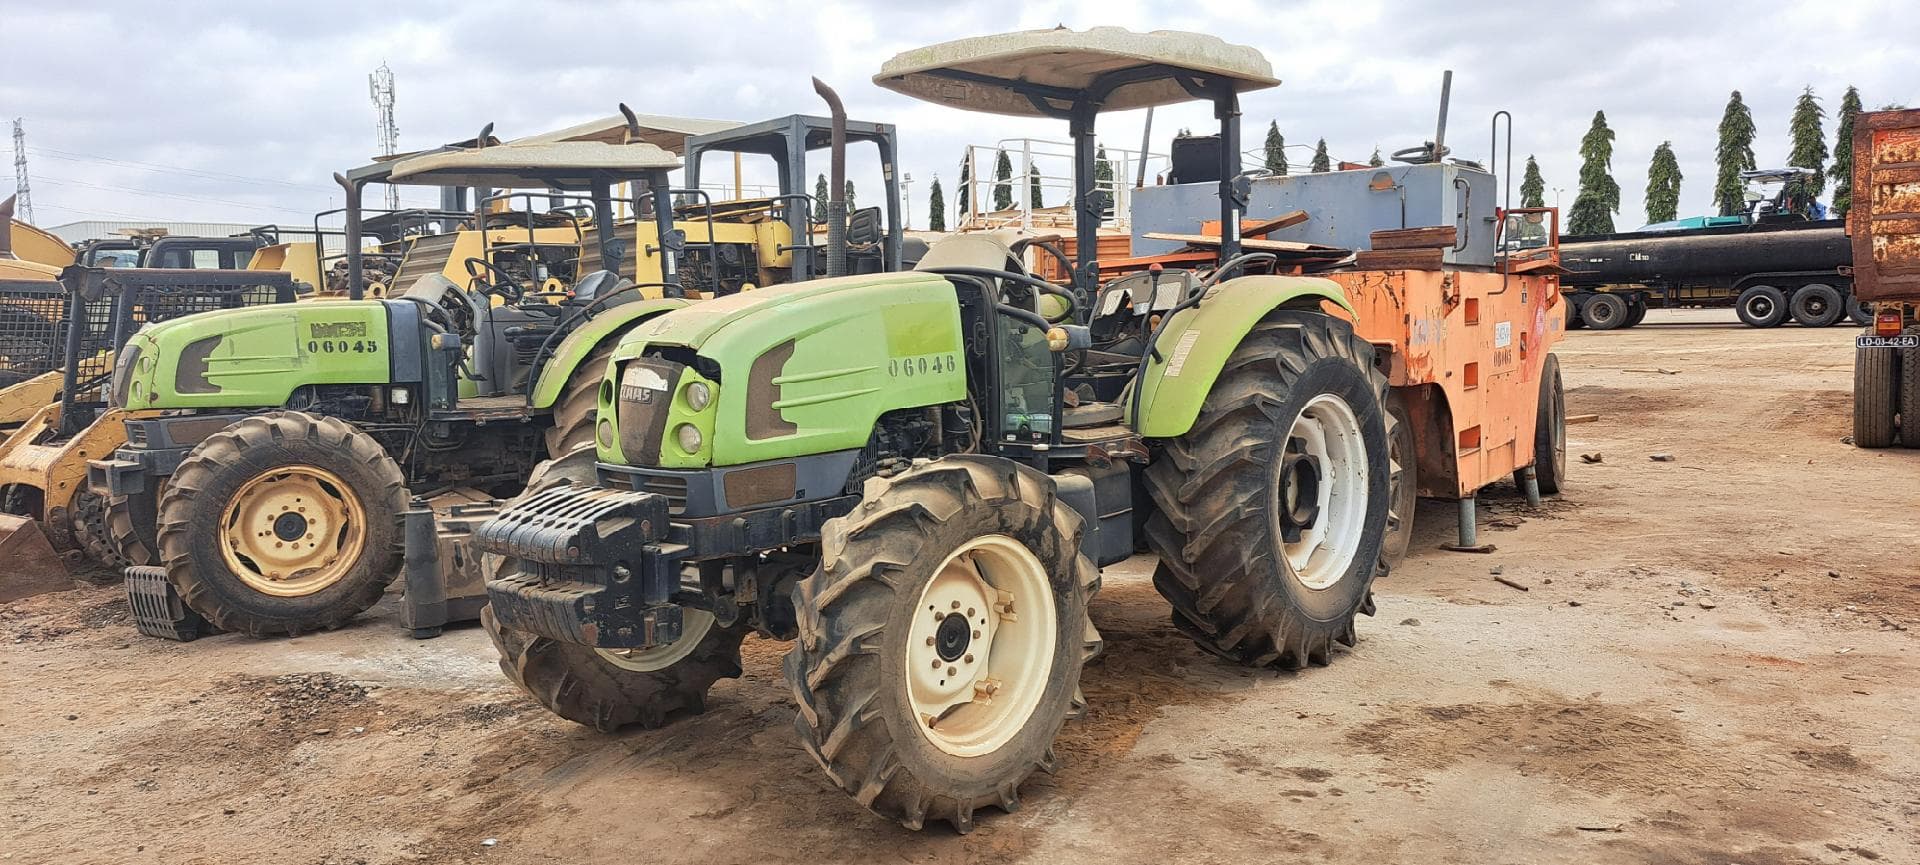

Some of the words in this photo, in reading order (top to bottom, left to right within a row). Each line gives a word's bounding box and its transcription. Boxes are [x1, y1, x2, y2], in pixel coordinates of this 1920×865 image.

[308, 340, 378, 353] 06045
[1860, 337, 1914, 346] LD-03-42-EA
[888, 355, 956, 378] 06046
